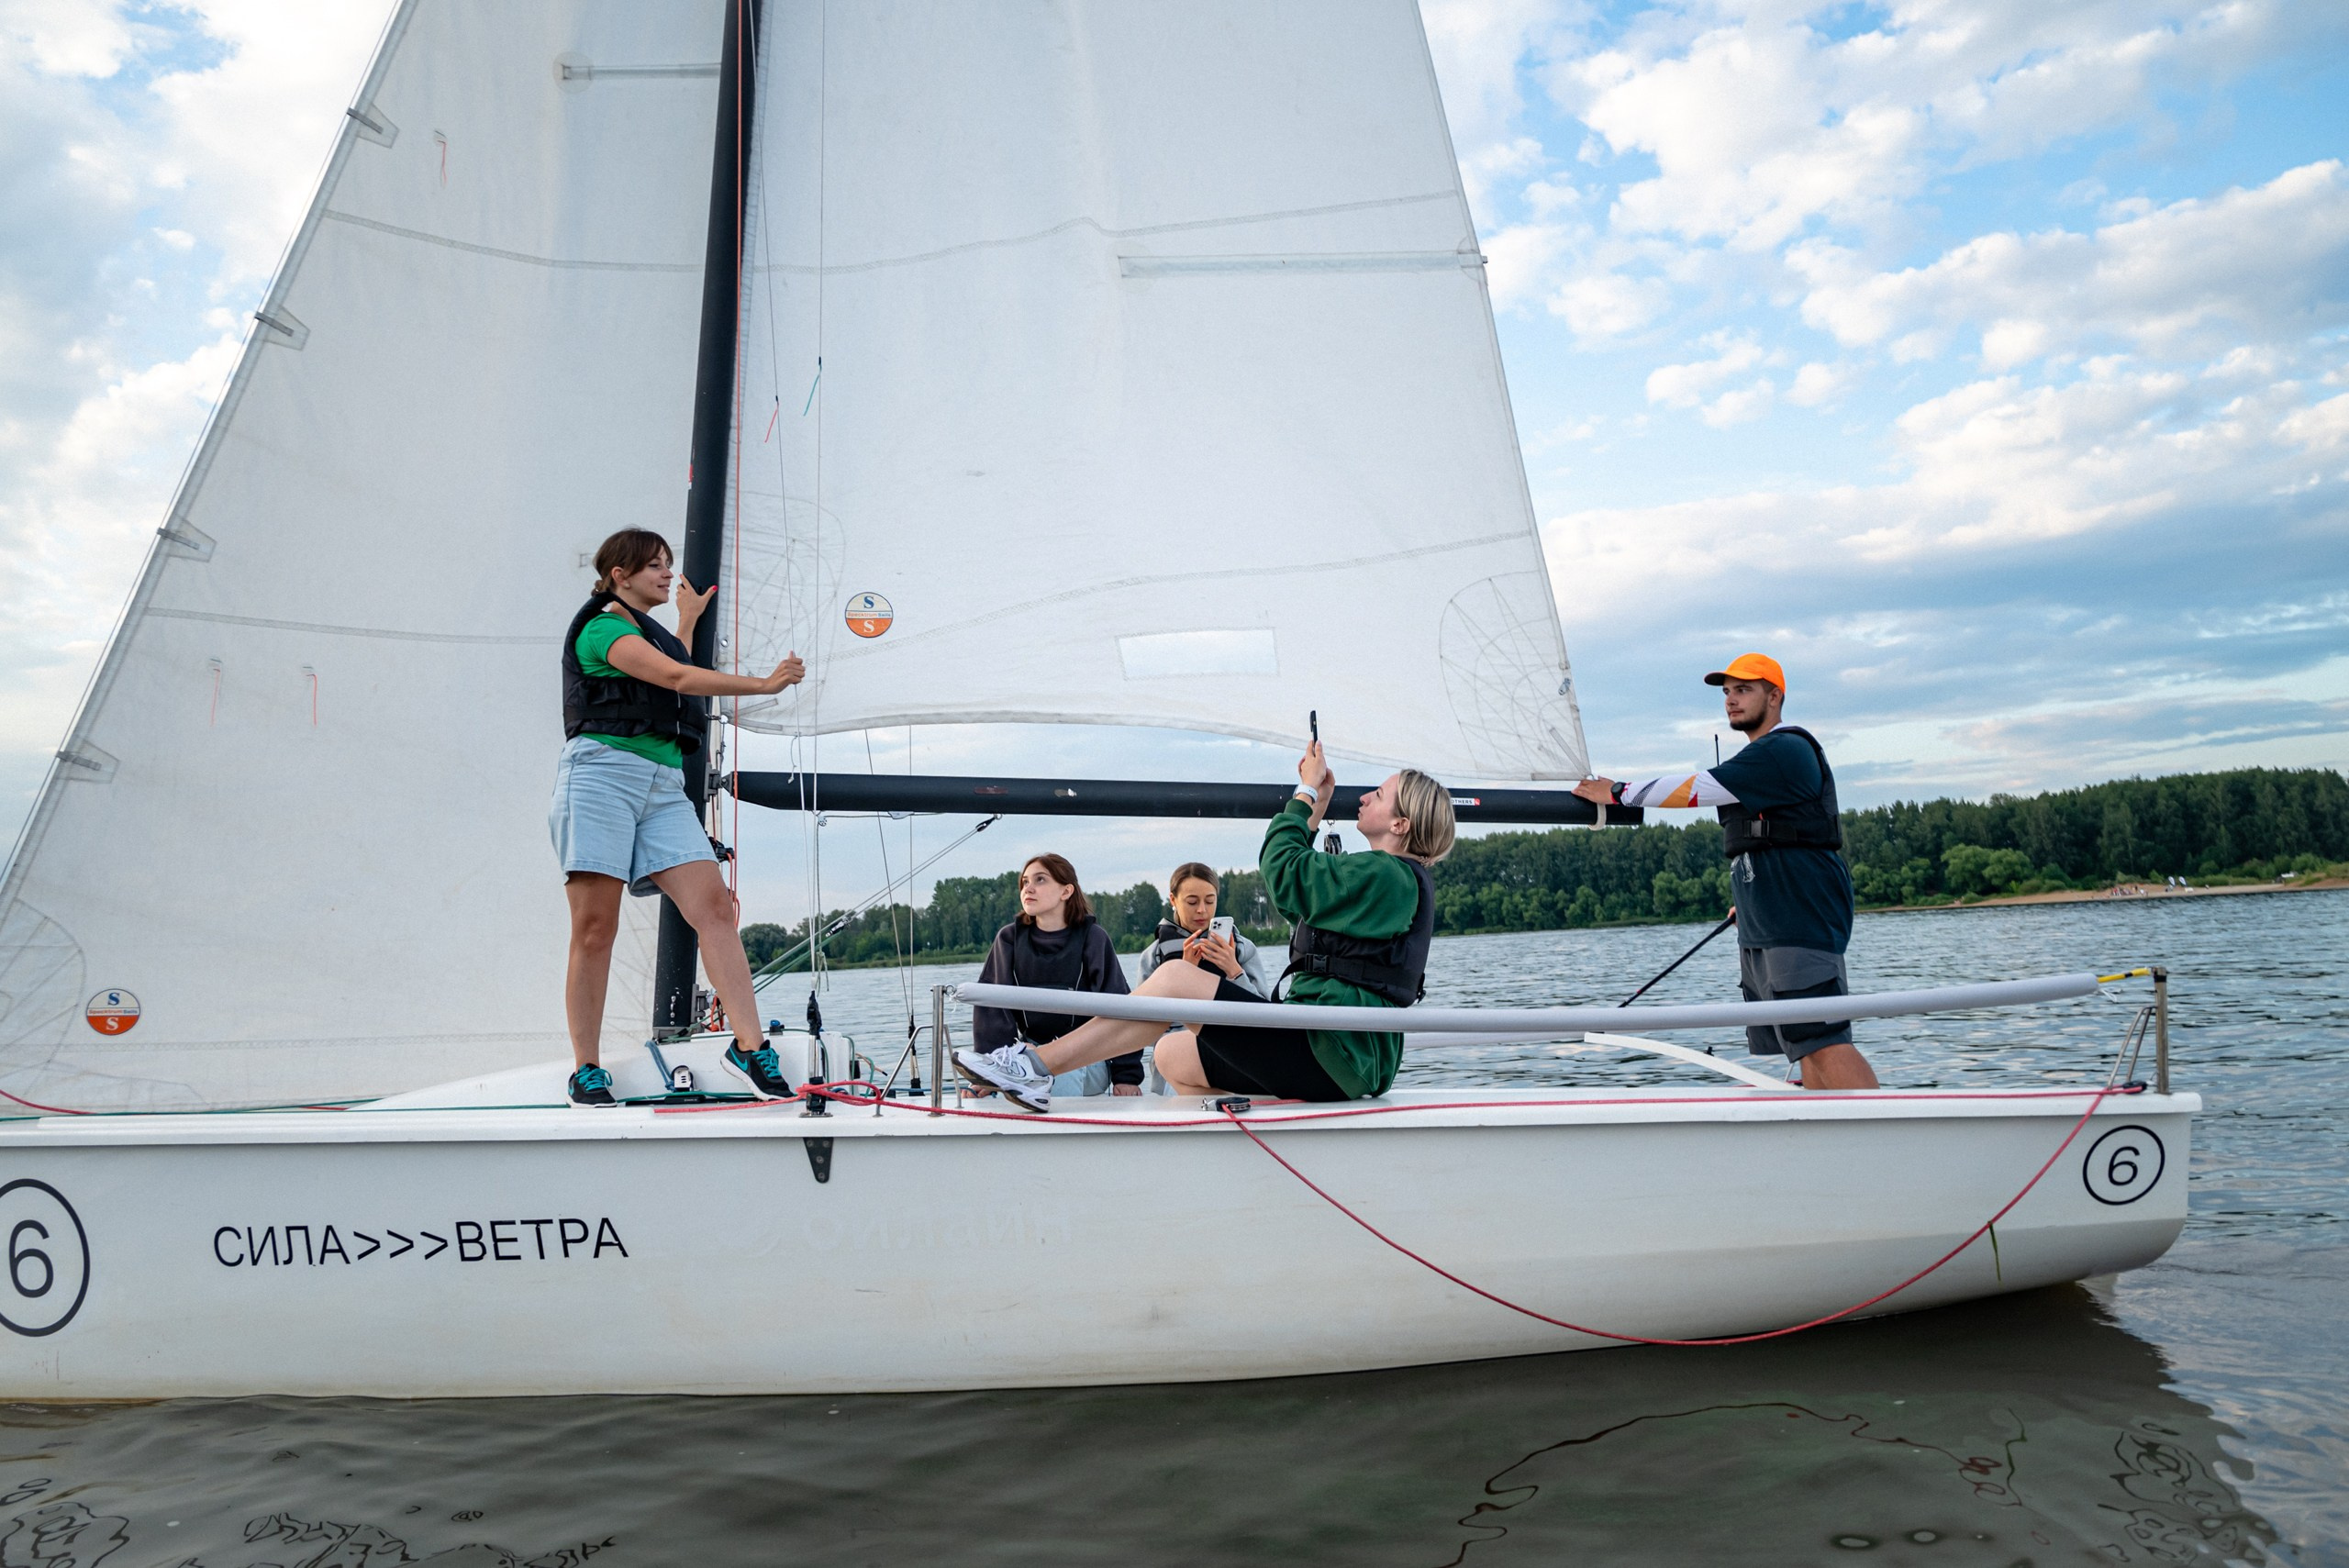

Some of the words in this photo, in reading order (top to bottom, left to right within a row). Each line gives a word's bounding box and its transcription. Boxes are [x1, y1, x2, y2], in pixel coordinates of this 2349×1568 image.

[863, 596, 874, 608] S
[863, 620, 874, 632] S
[108, 992, 119, 1005] S
[106, 1018, 118, 1029] S
[2108, 1146, 2141, 1186] 6
[9, 1219, 54, 1298] 6
